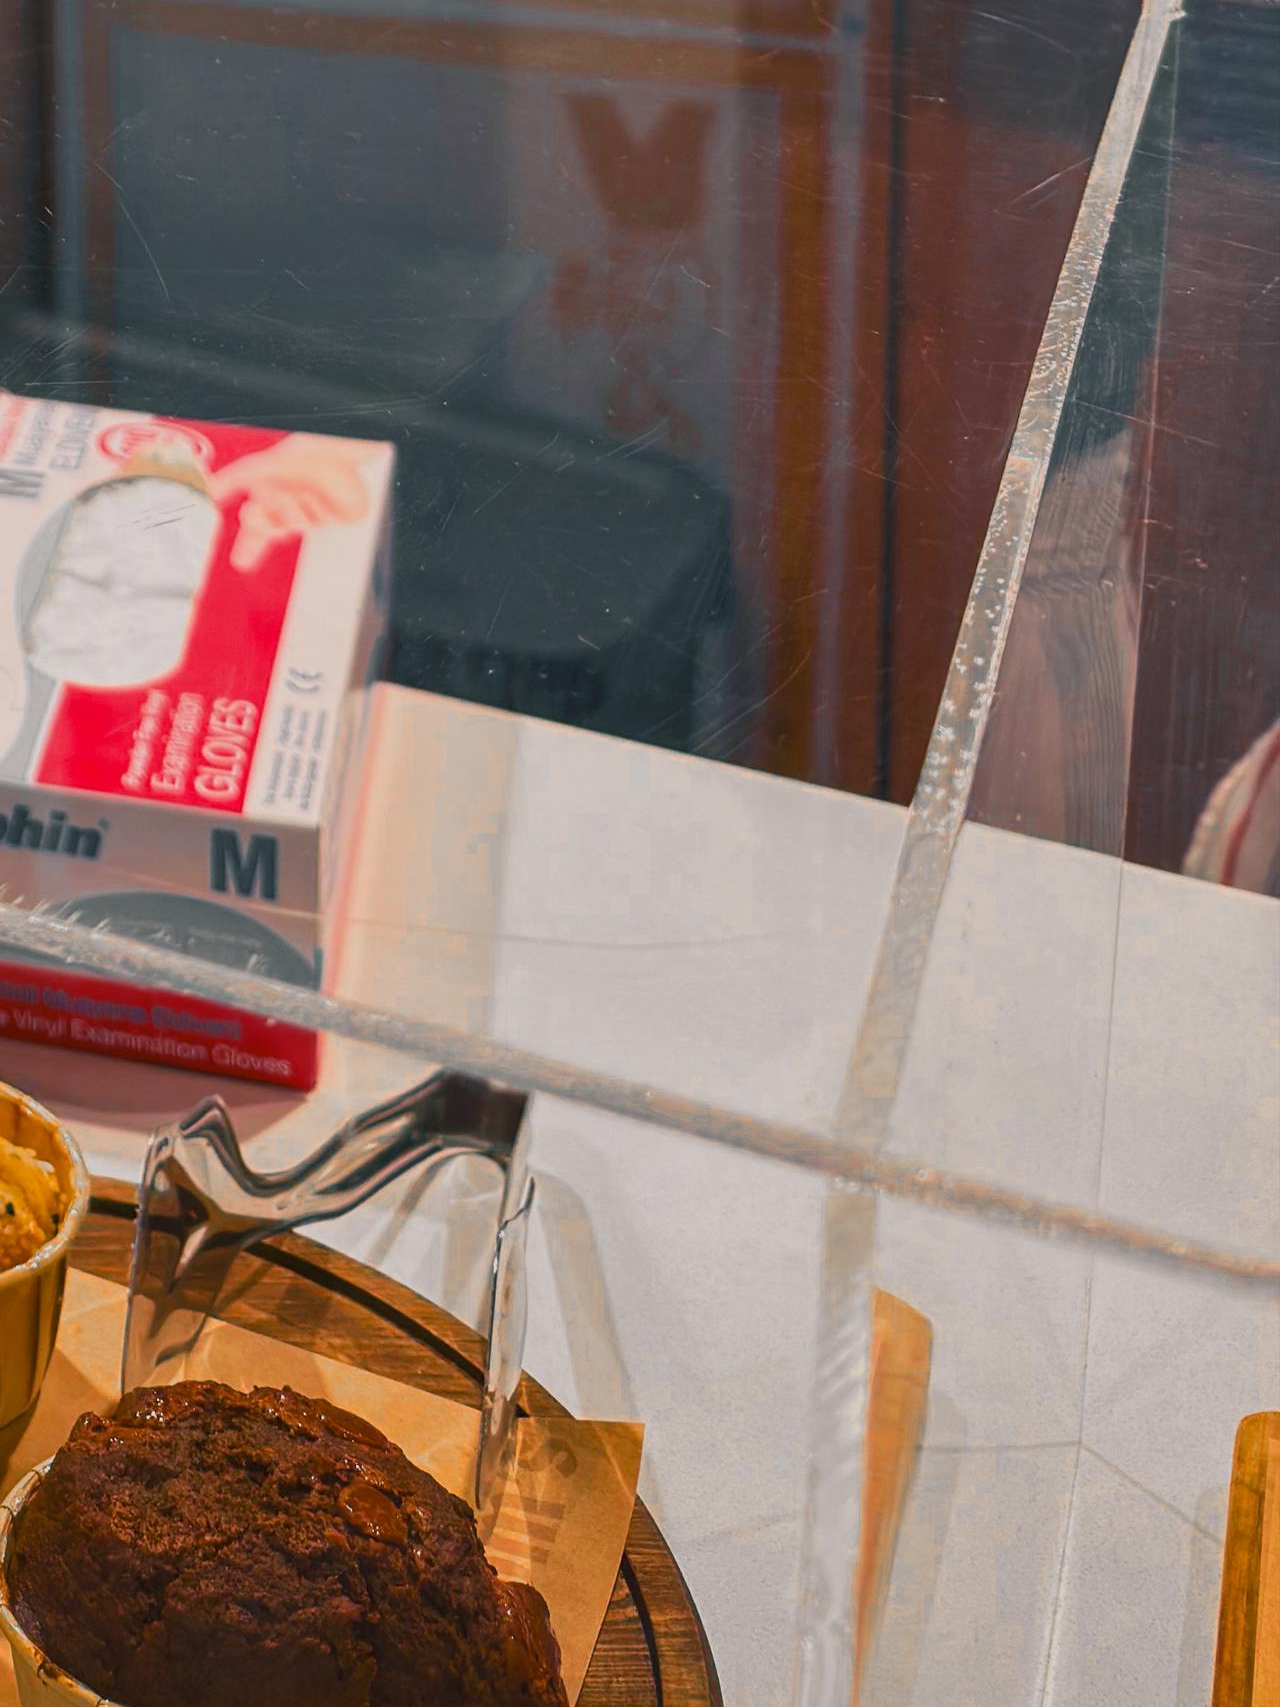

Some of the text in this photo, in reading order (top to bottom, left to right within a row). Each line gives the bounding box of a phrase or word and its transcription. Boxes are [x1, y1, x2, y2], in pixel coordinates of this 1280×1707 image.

[151, 692, 205, 793] Examination
[194, 697, 258, 802] GLOVES
[208, 826, 280, 902] M
[13, 1008, 66, 1039] Vinyl
[71, 1017, 209, 1063] Examination
[212, 1043, 292, 1077] Gloves
